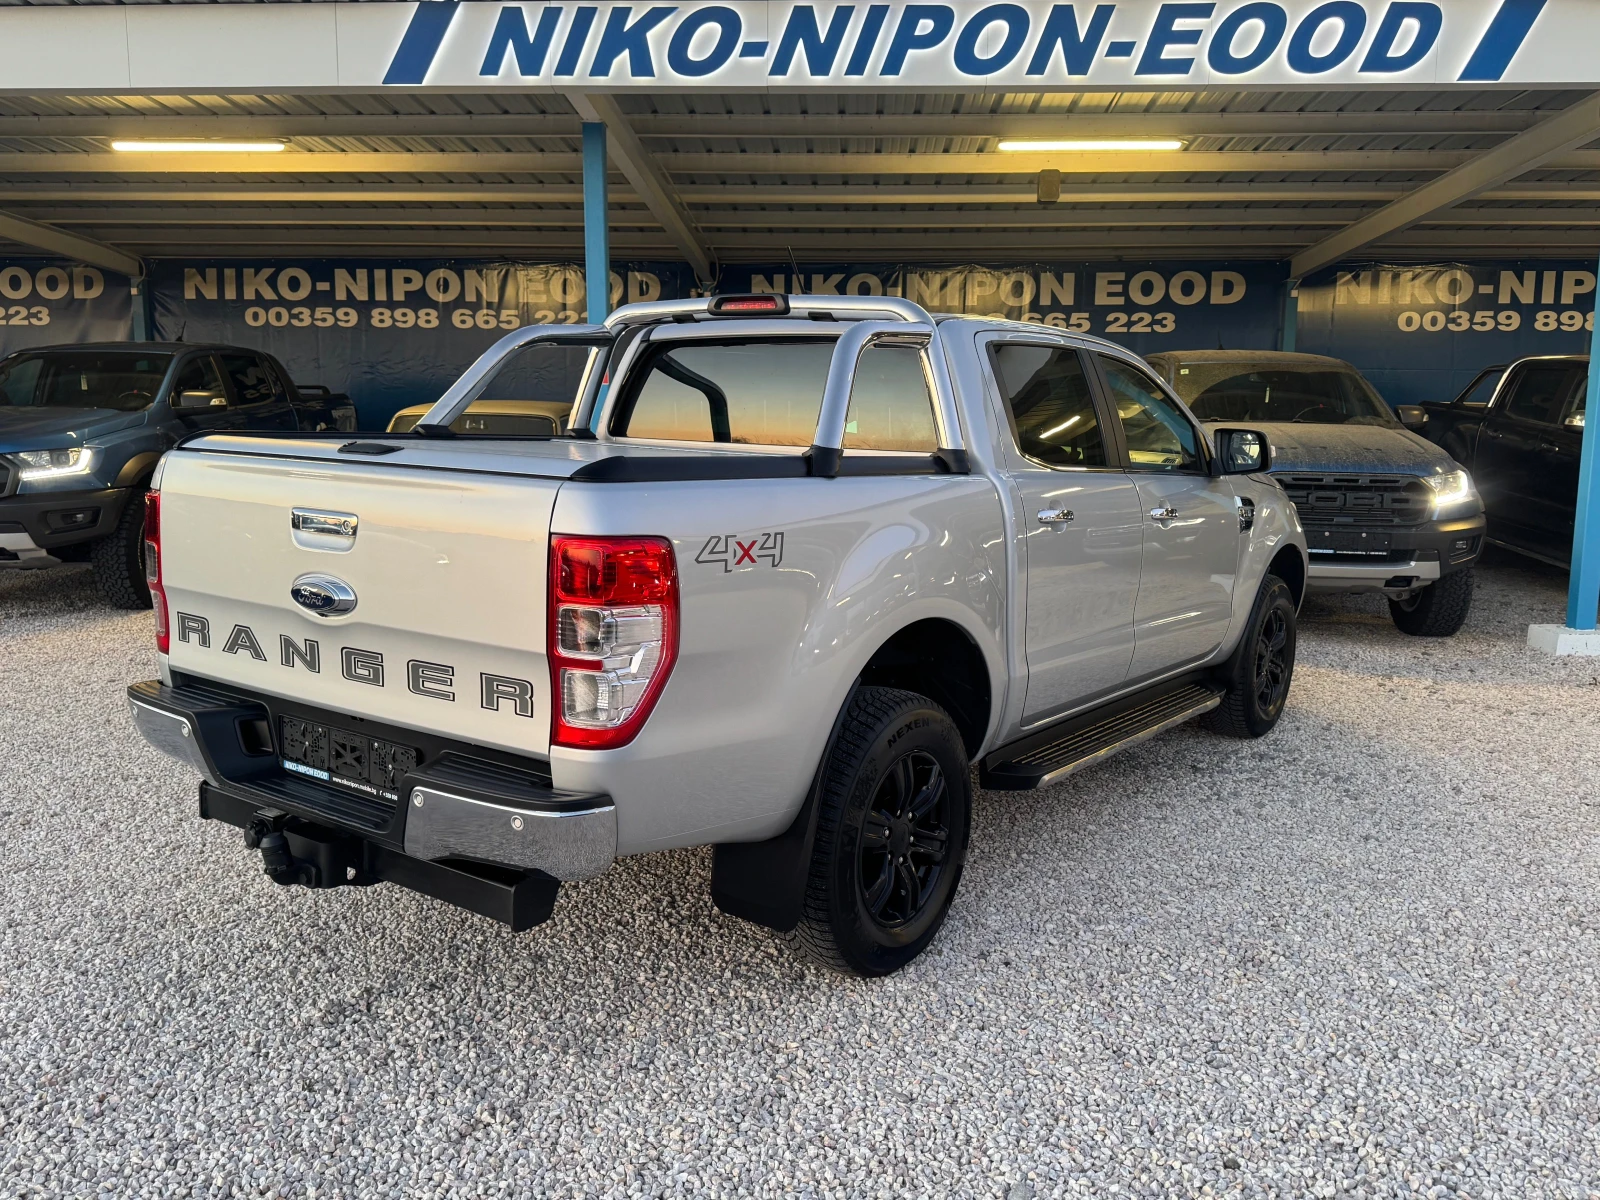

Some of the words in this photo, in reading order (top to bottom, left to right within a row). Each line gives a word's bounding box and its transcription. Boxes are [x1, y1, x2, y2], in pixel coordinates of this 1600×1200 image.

[479, 1, 1443, 78] NIKO-NIPON-EOOD
[184, 267, 498, 303] NIKO-NIPON
[751, 272, 1075, 306] NIKO-NIPON
[1094, 271, 1246, 305] EOOD
[244, 307, 359, 328] 00359
[370, 308, 440, 329] 898
[452, 308, 520, 330] 665
[1104, 312, 1176, 333] 223
[1397, 310, 1521, 332] 00359
[694, 531, 785, 574] 4x4
[298, 586, 324, 606] Ford
[177, 611, 534, 719] RANGER
[887, 717, 930, 749] NEXEN
